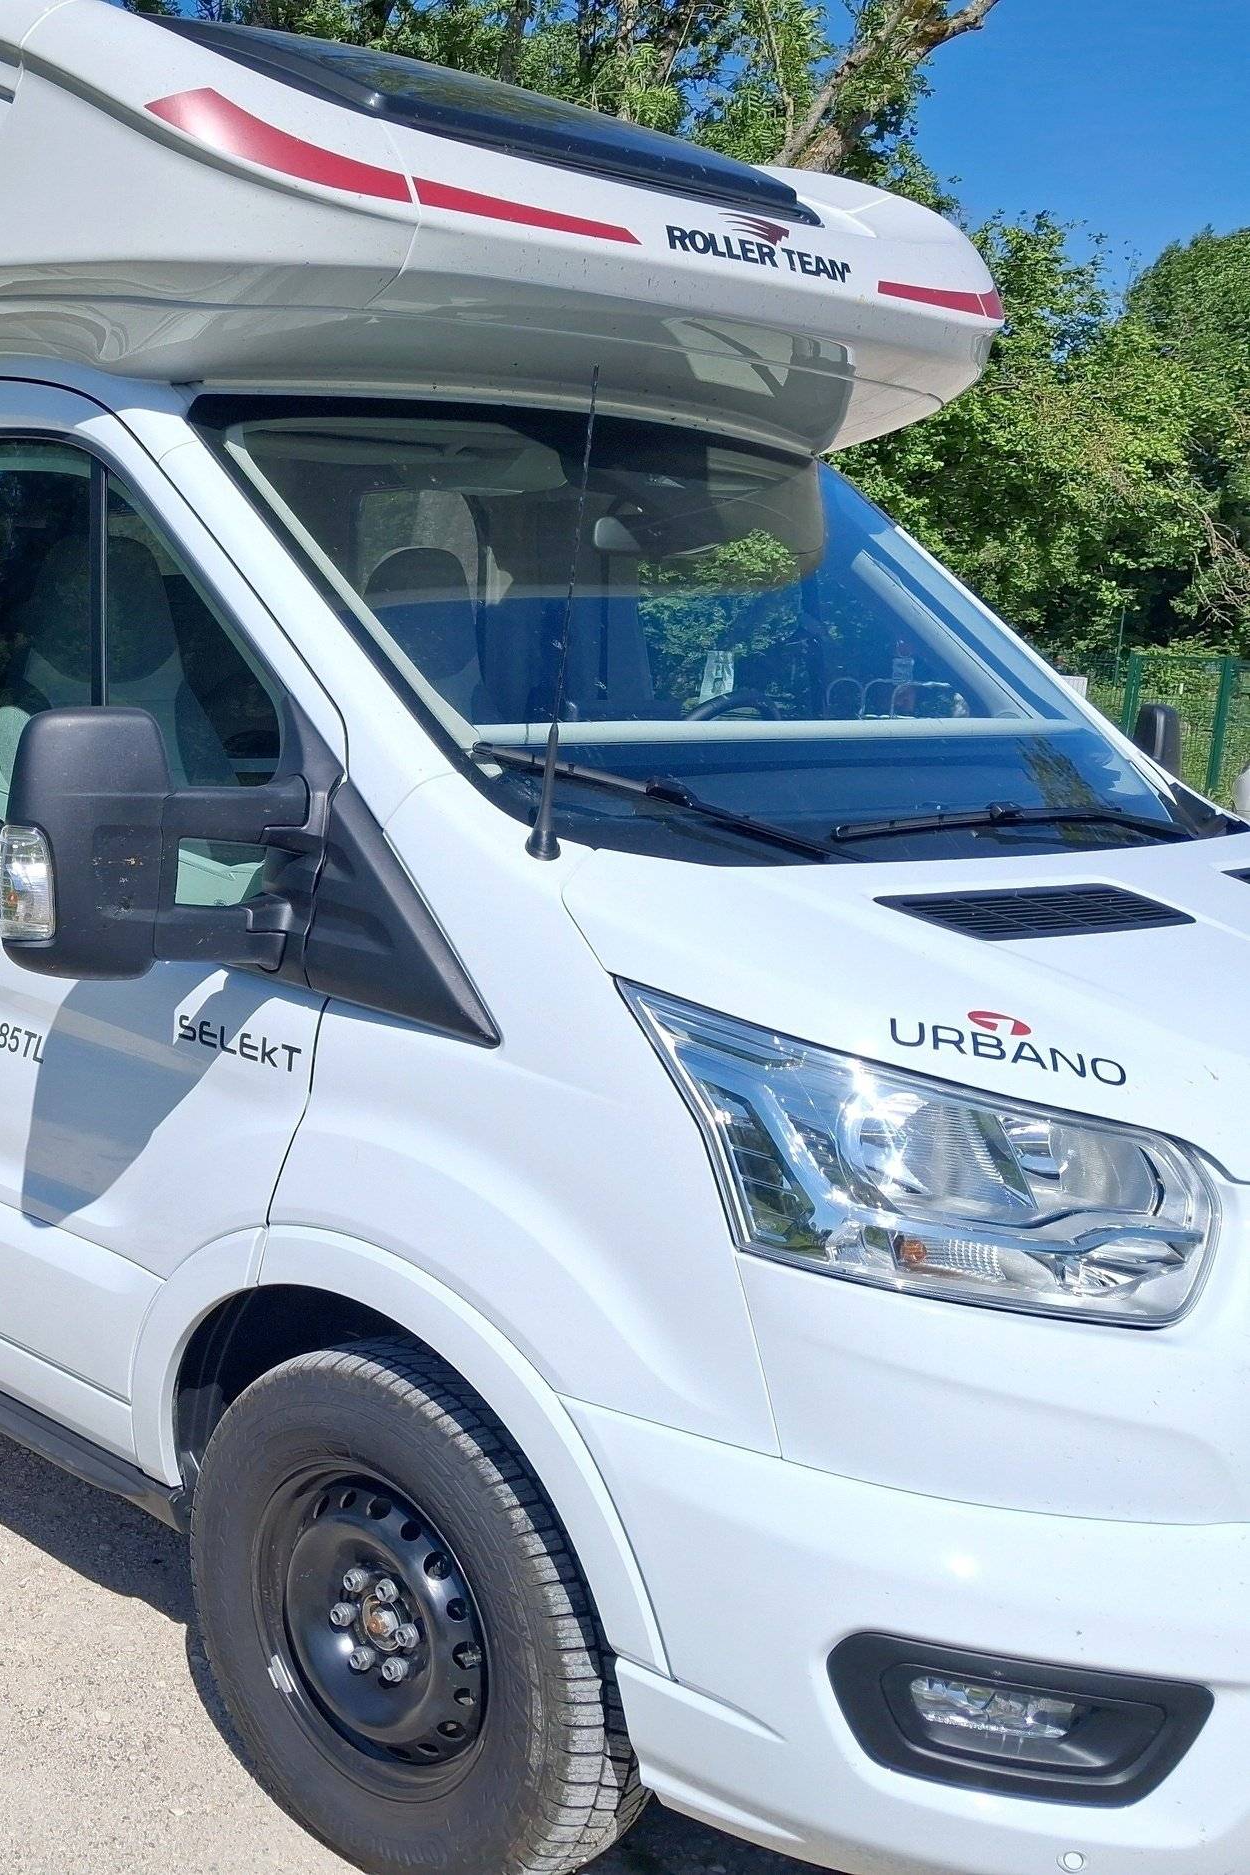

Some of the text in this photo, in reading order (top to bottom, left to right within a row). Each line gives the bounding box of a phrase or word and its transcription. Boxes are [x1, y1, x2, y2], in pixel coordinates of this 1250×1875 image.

[666, 225, 852, 284] ROLLER TEAM
[890, 1017, 1126, 1086] URBANO
